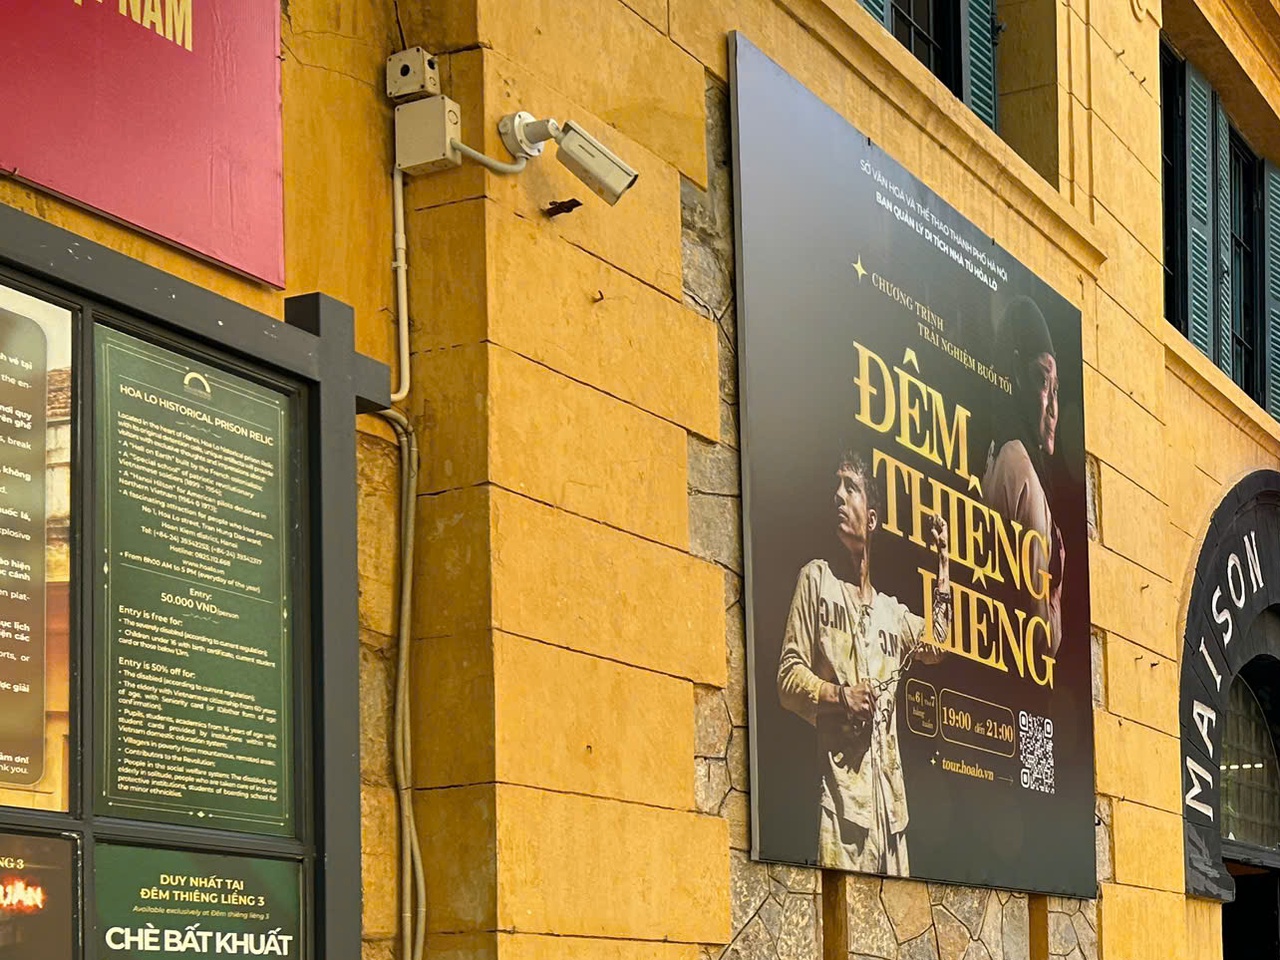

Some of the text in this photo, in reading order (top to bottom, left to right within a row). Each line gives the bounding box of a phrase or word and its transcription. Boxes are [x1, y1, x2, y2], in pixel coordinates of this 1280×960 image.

[872, 272, 944, 331] CHƯƠNG TRÌNH
[918, 322, 1012, 395] TRẢI NGHIỆM BUỔI TỐI
[1, 374, 32, 389] the en-
[15, 409, 32, 421] quy
[120, 384, 273, 446] HOA LO HISTORICAL PRISON RELIC
[853, 340, 971, 479] ĐÊM
[8, 436, 31, 450] break
[2, 465, 31, 482] không
[872, 448, 1053, 603] THIÊNG
[124, 551, 142, 561] From
[161, 561, 172, 569] AM
[10, 591, 30, 602] plat-
[160, 592, 193, 608] 50.000
[189, 587, 212, 600] Entry:
[118, 604, 182, 626] Entry is free for:
[14, 621, 30, 632] lịch
[14, 632, 30, 642] các
[118, 656, 195, 678] Entry is 50% off for:
[1186, 530, 1264, 822] MAISON
[942, 706, 971, 731] 19:00
[986, 719, 1013, 743] 21:00
[11, 766, 29, 774] you.
[942, 757, 994, 780] tour.hoalo.vn
[16, 858, 25, 870] 3
[160, 874, 243, 892] DUY NHẤT TẠI
[139, 886, 264, 906] ĐÊM THIÊNG LIÊNG 3
[105, 922, 292, 955] CHÈ BẤT KHUẤT
